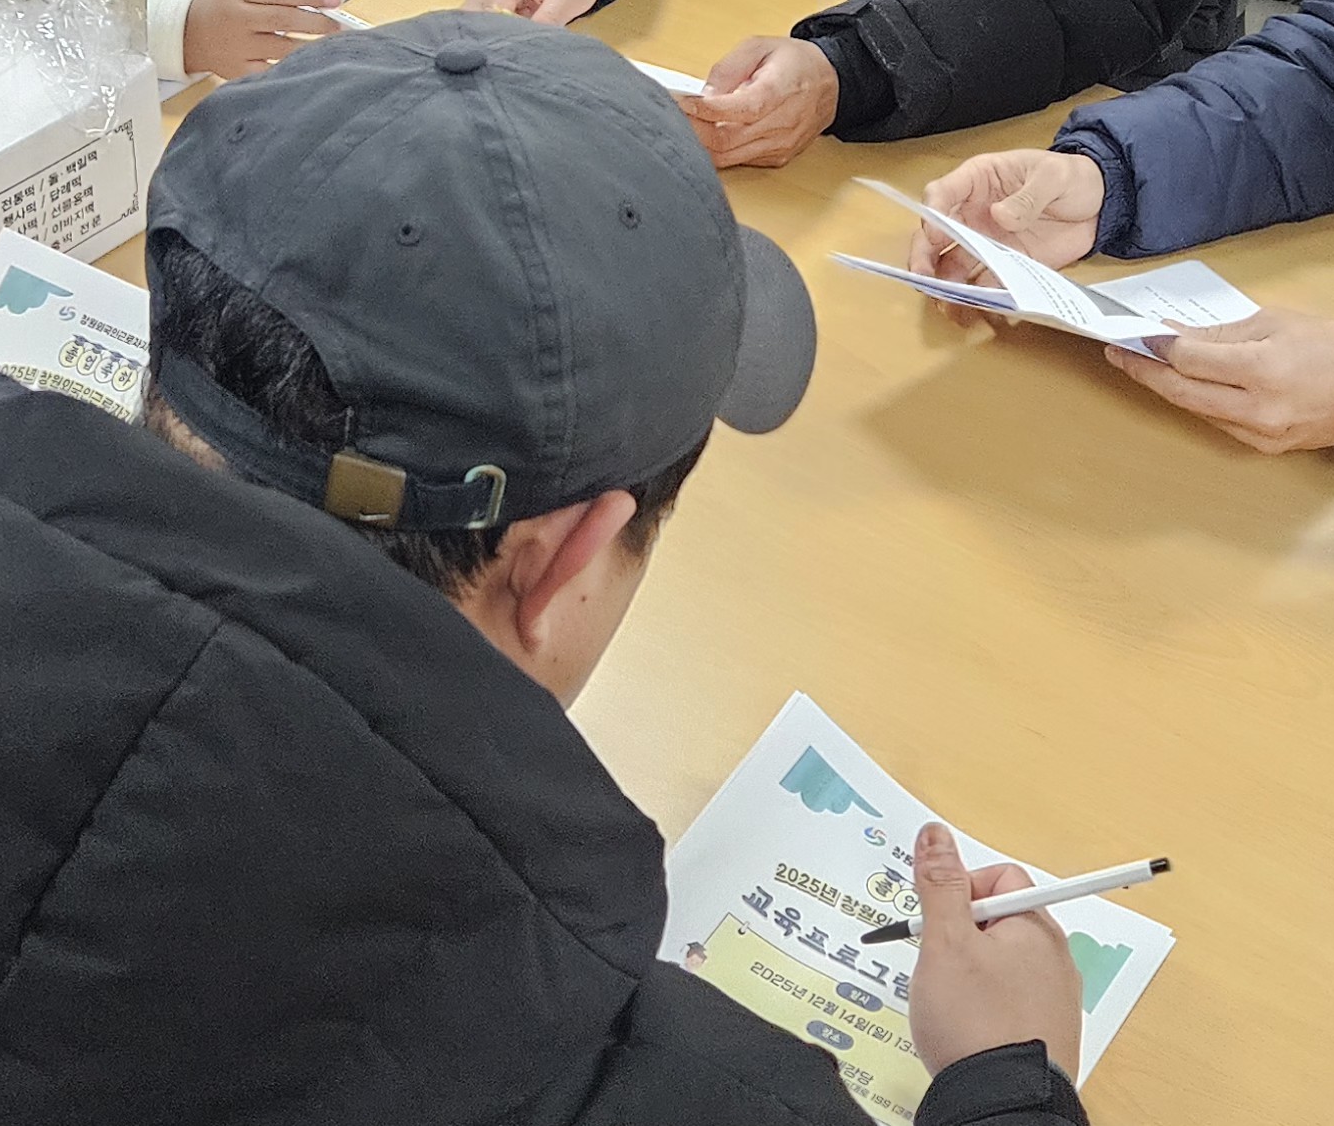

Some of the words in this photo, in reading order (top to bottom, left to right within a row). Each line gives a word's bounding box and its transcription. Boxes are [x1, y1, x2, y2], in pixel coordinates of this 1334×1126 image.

[1, 185, 36, 212] 전통떡
[775, 863, 841, 907] 2025년
[750, 961, 808, 1001] 2025년
[807, 992, 840, 1017] 12월
